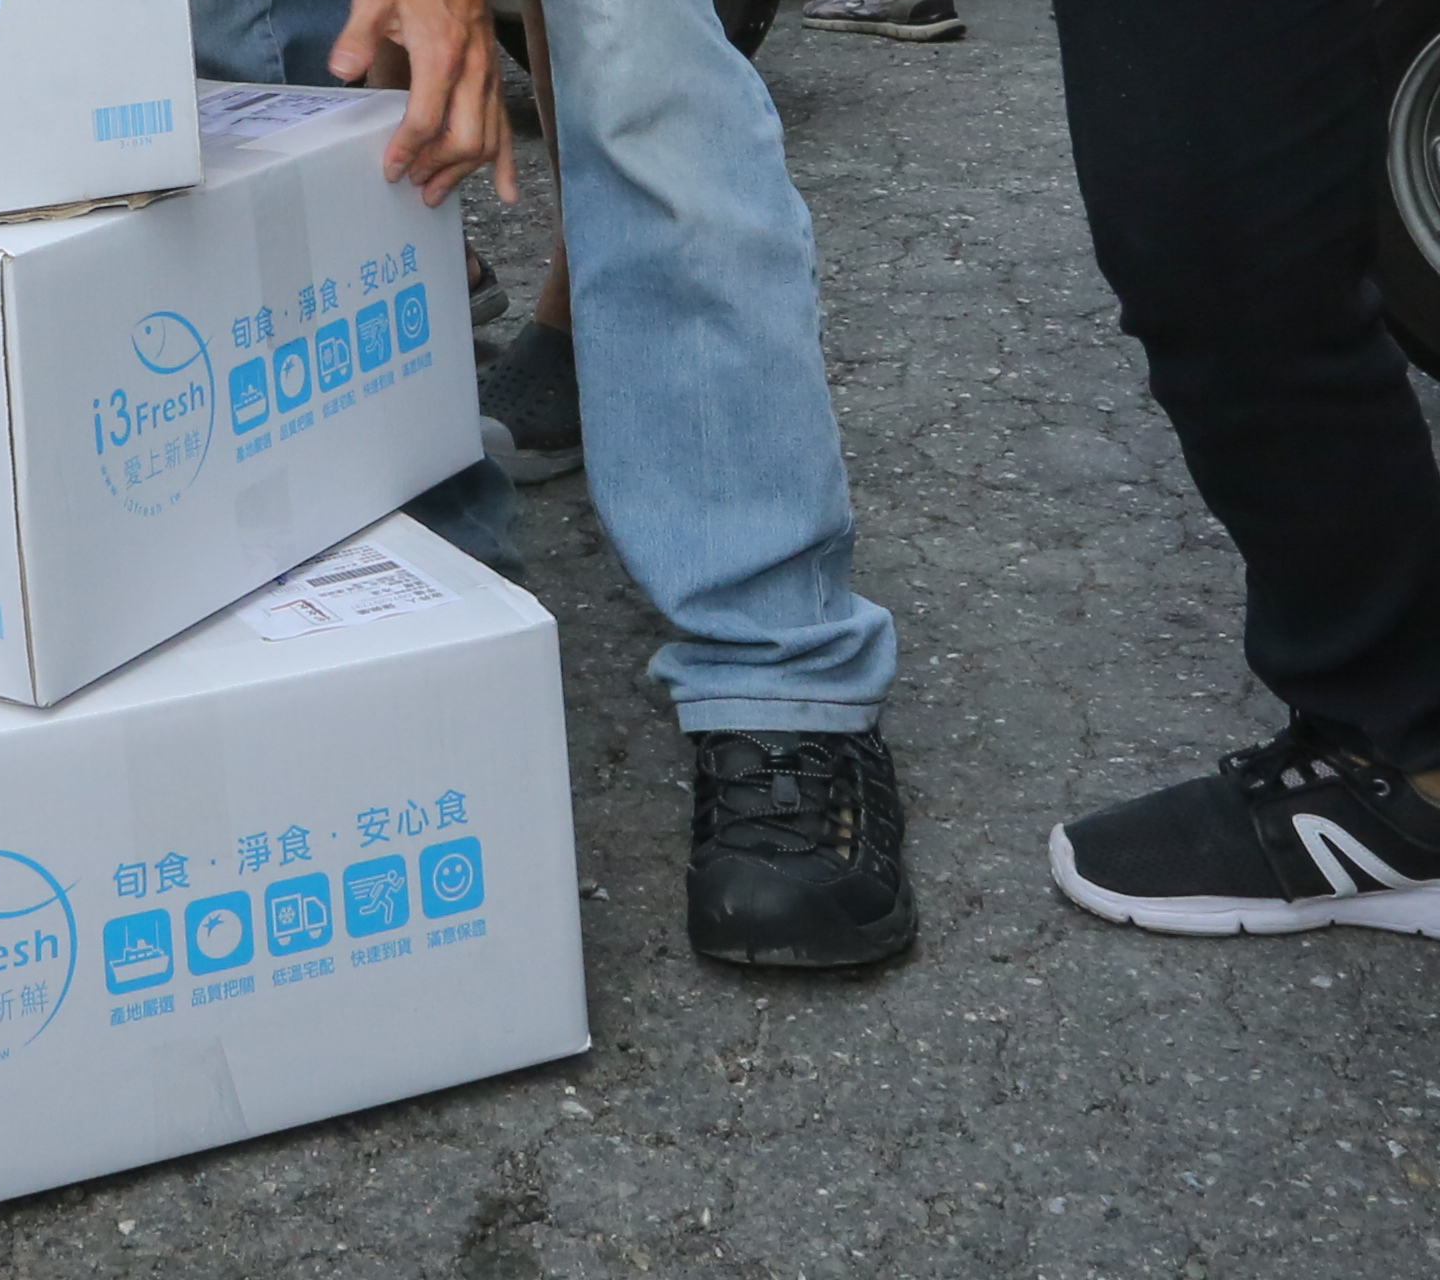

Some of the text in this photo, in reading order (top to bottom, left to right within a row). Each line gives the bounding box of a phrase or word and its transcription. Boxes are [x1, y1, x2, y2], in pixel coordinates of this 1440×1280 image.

[93, 381, 205, 456] i3Fresh
[124, 427, 202, 490] 愛上新鮮
[350, 937, 413, 969] 快速到貨
